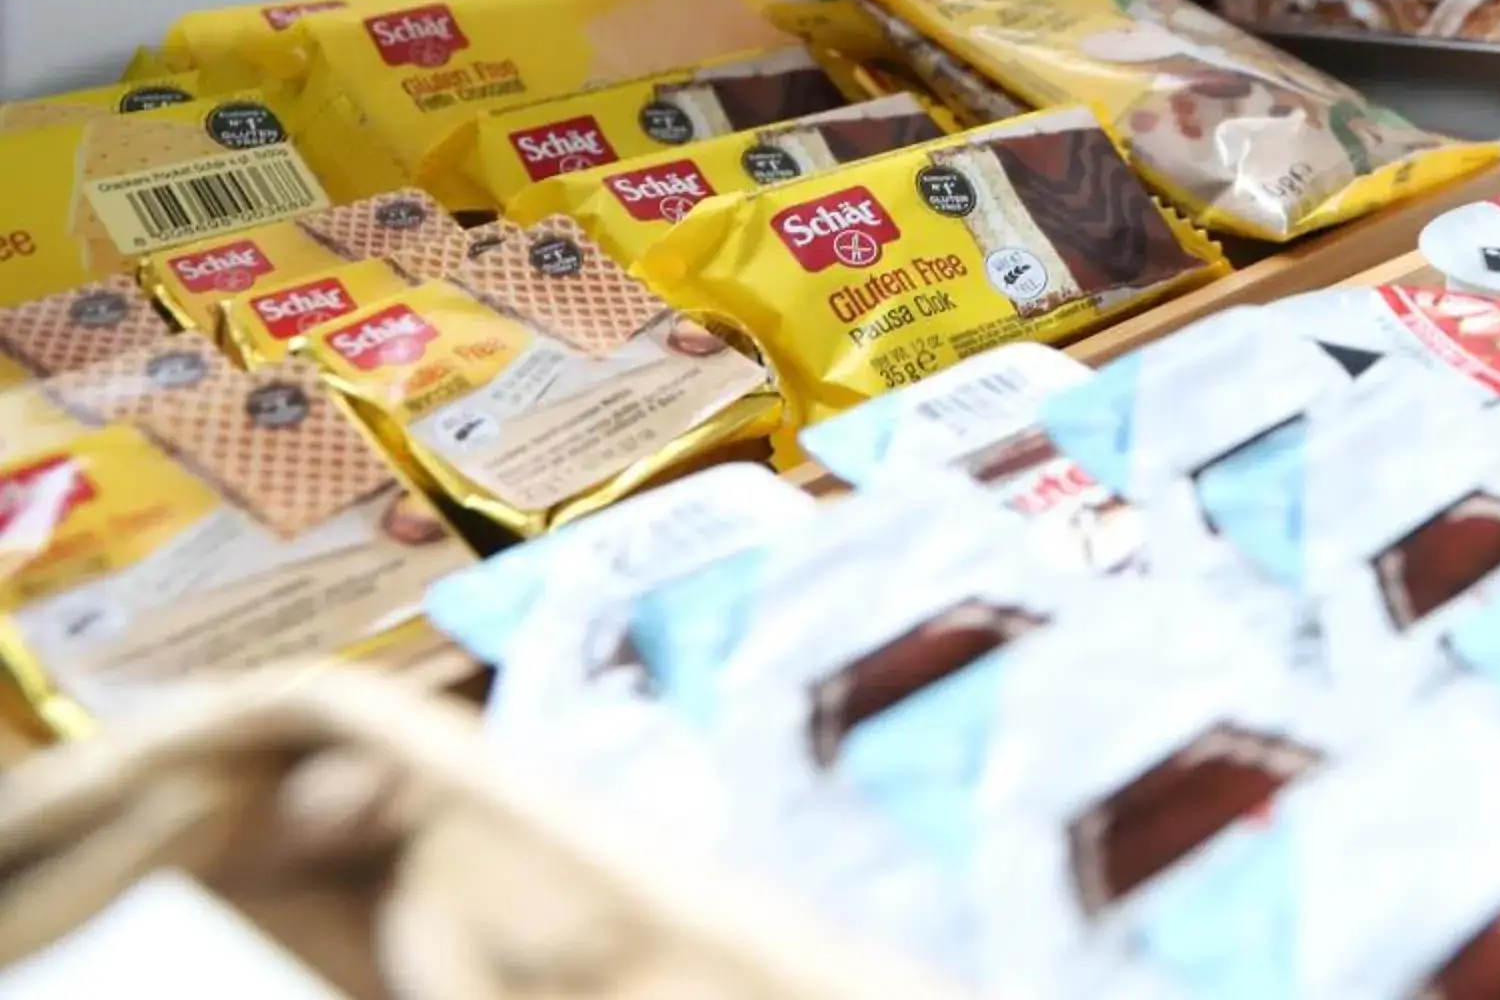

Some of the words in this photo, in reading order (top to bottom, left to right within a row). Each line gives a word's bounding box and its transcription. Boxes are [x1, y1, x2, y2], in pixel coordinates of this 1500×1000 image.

[372, 12, 454, 46] Schär
[517, 129, 605, 162] Schär
[613, 171, 707, 203] Schär
[782, 198, 883, 248] Schär
[176, 247, 261, 281] Schär
[257, 285, 346, 324] Schär
[828, 264, 918, 324] Gluten
[911, 253, 969, 287] Free
[848, 303, 916, 349] Pausa
